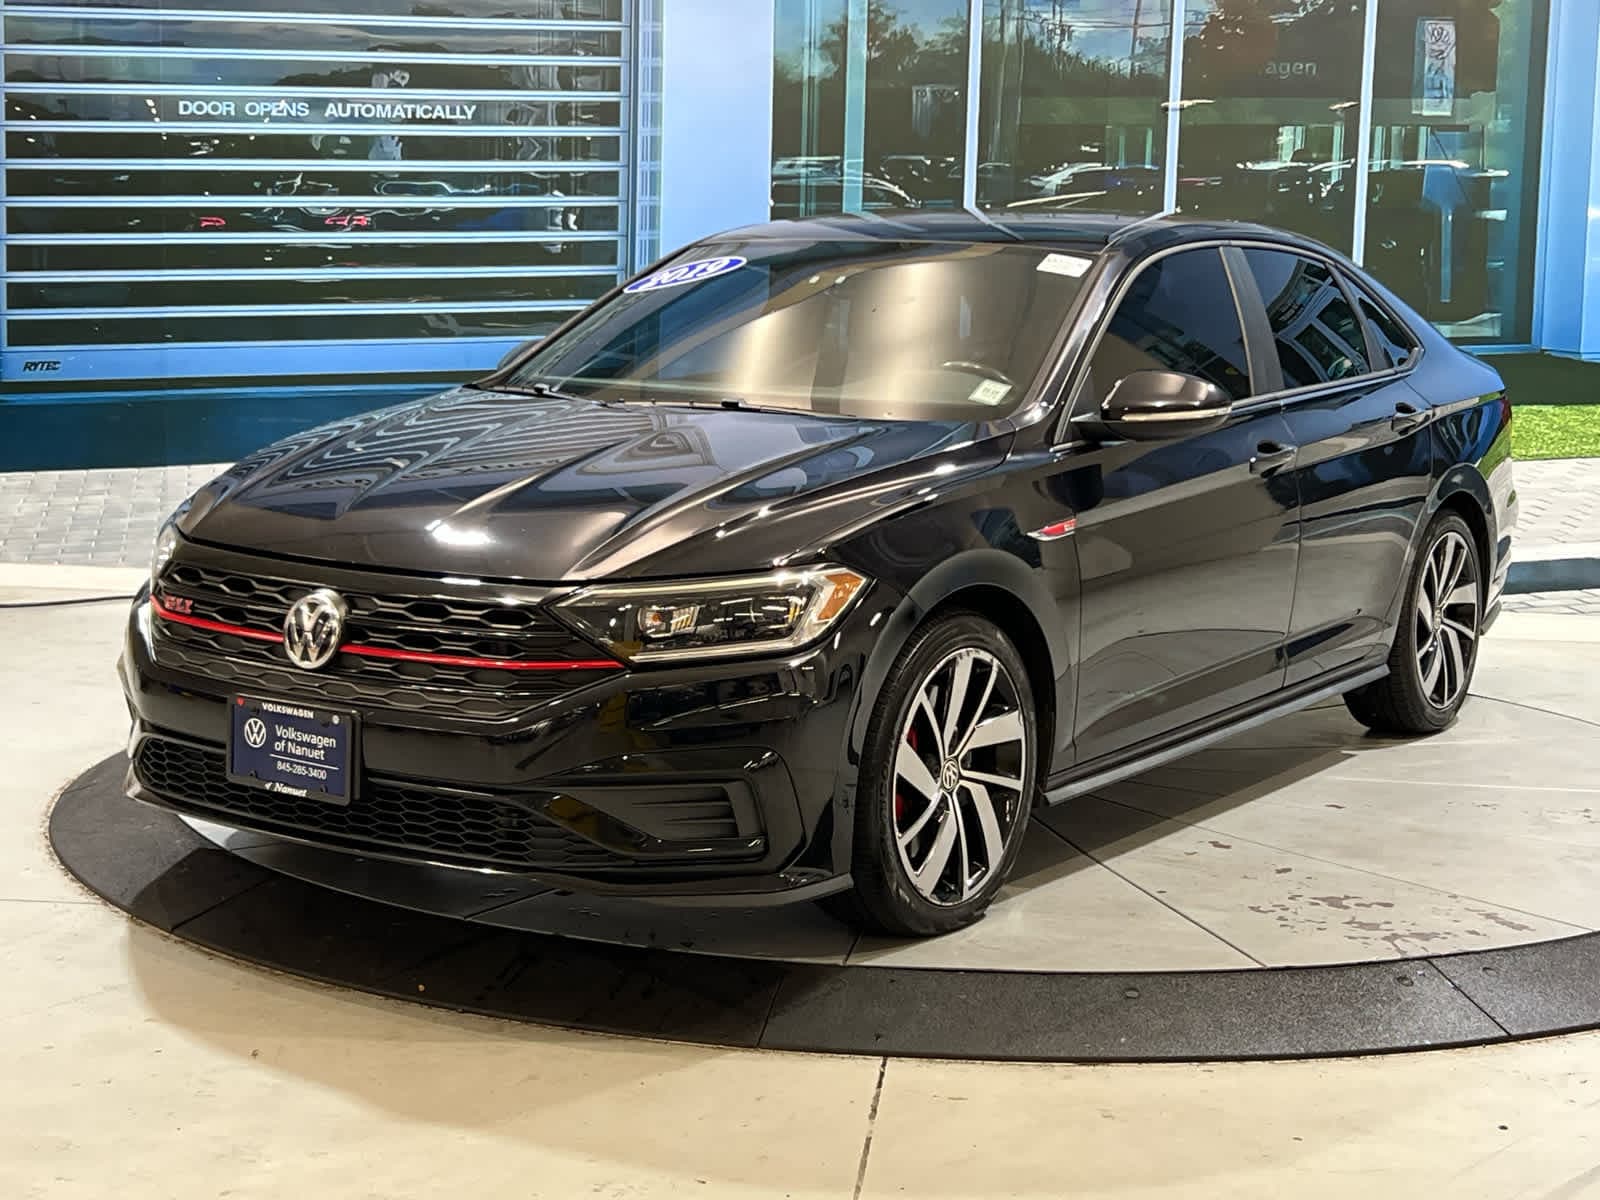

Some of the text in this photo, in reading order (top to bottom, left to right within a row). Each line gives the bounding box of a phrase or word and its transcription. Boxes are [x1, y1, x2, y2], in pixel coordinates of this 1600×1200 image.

[178, 100, 477, 120] DOOR OPENS AUTOMATICALLY
[261, 702, 315, 720] VOLKSWAGEN
[275, 724, 337, 748] Volkswagen
[274, 740, 326, 761] of Nanuet
[276, 760, 328, 781] 845-285-3400
